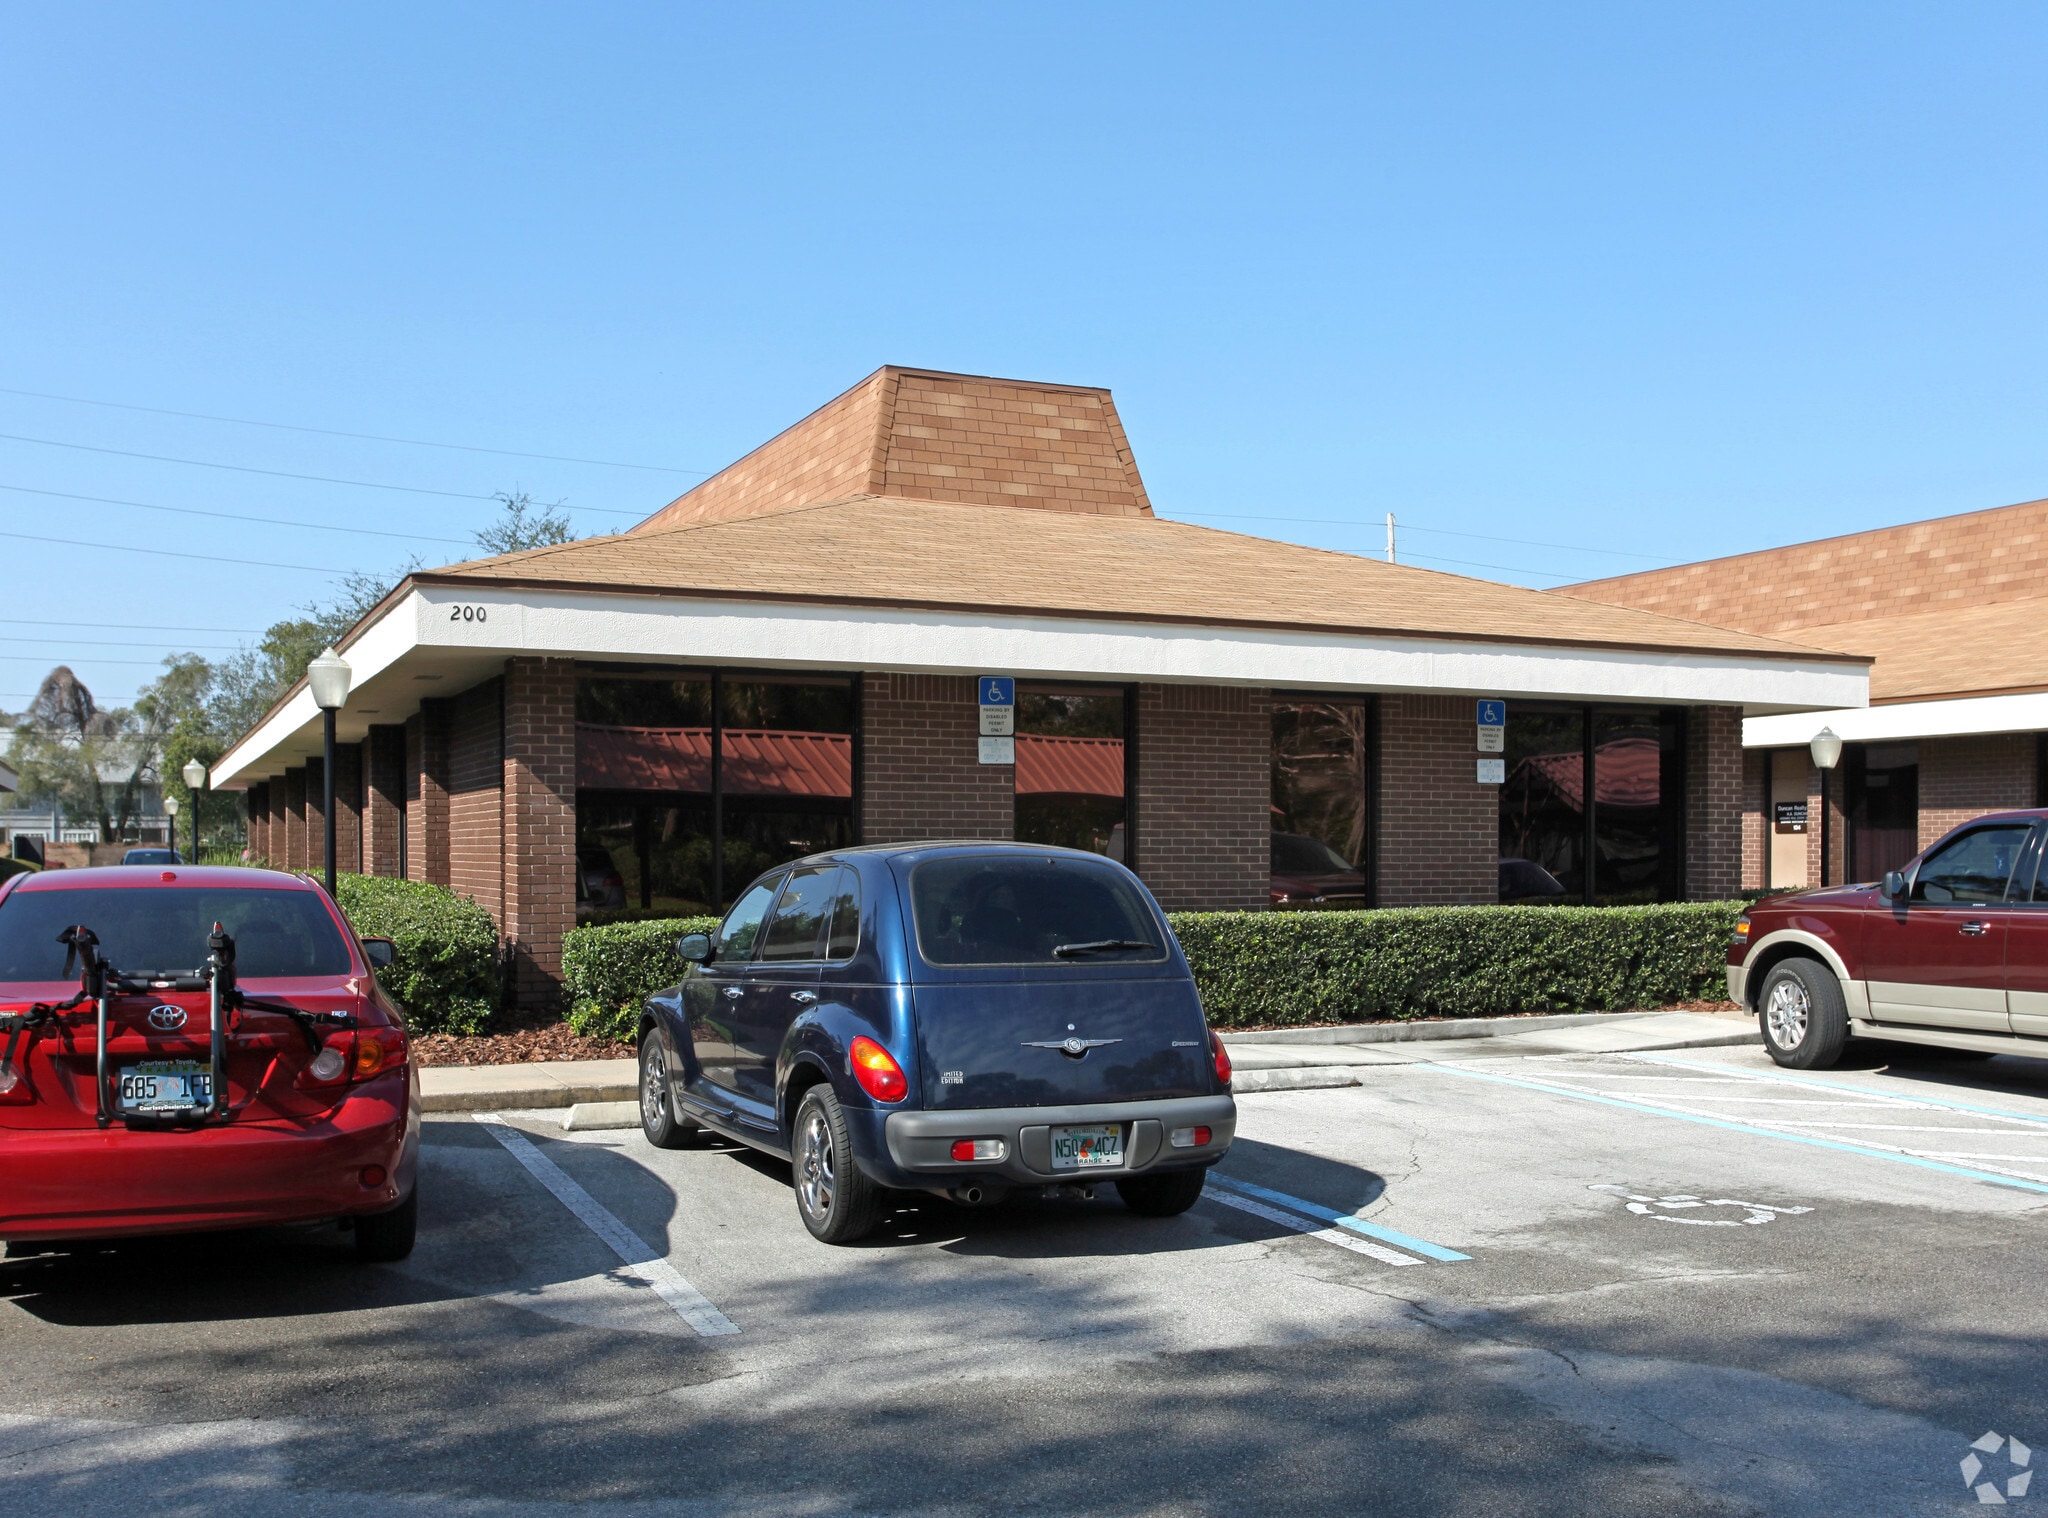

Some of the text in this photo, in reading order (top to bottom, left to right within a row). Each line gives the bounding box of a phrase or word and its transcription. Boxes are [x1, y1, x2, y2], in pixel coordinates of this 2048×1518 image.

[450, 605, 486, 622] 200
[123, 1076, 156, 1100] 685
[139, 1103, 193, 1111] CourtesyDealers.co
